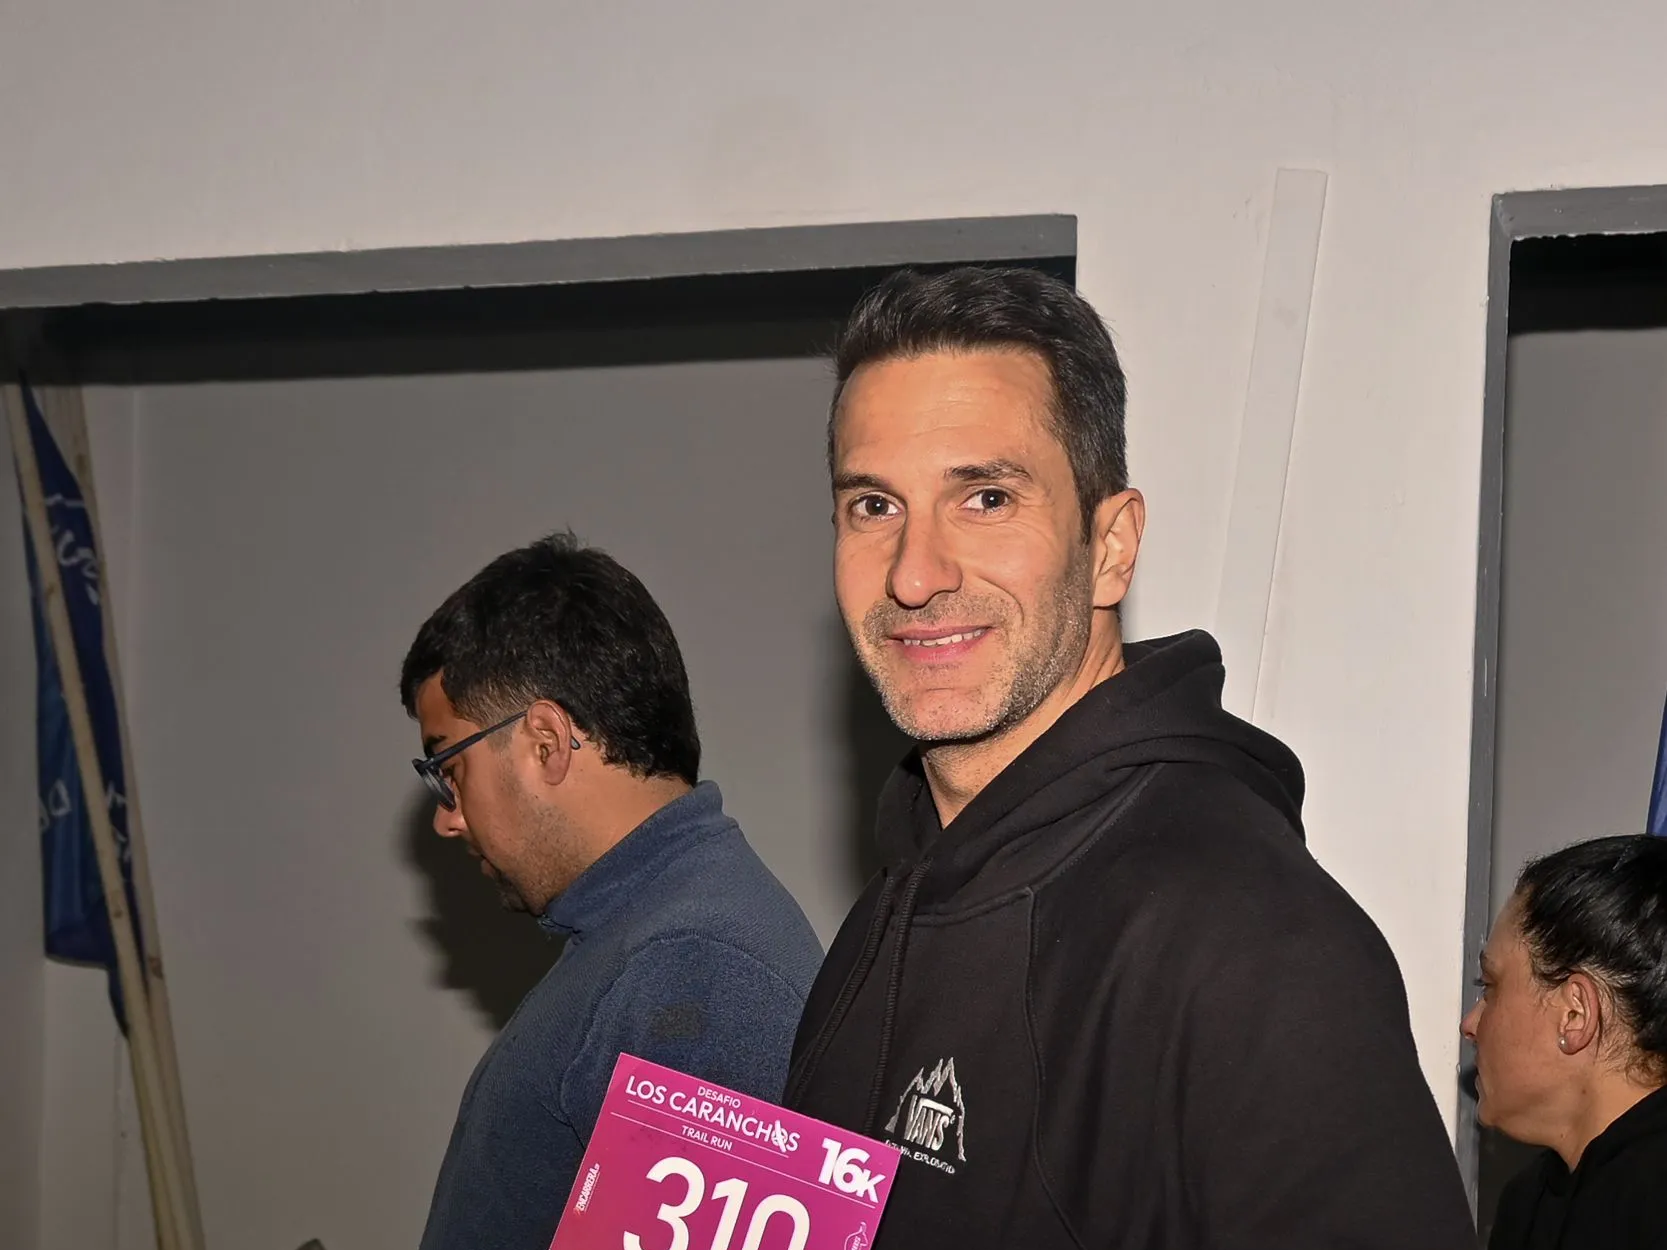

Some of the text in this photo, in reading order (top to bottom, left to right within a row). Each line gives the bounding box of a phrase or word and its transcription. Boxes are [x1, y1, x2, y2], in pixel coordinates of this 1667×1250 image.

[625, 1075, 800, 1153] LOS CARANCHOS
[697, 1085, 741, 1109] DESAFIO
[904, 1094, 954, 1151] VANS
[682, 1125, 733, 1152] TRAIL RUN
[818, 1137, 886, 1203] 16K
